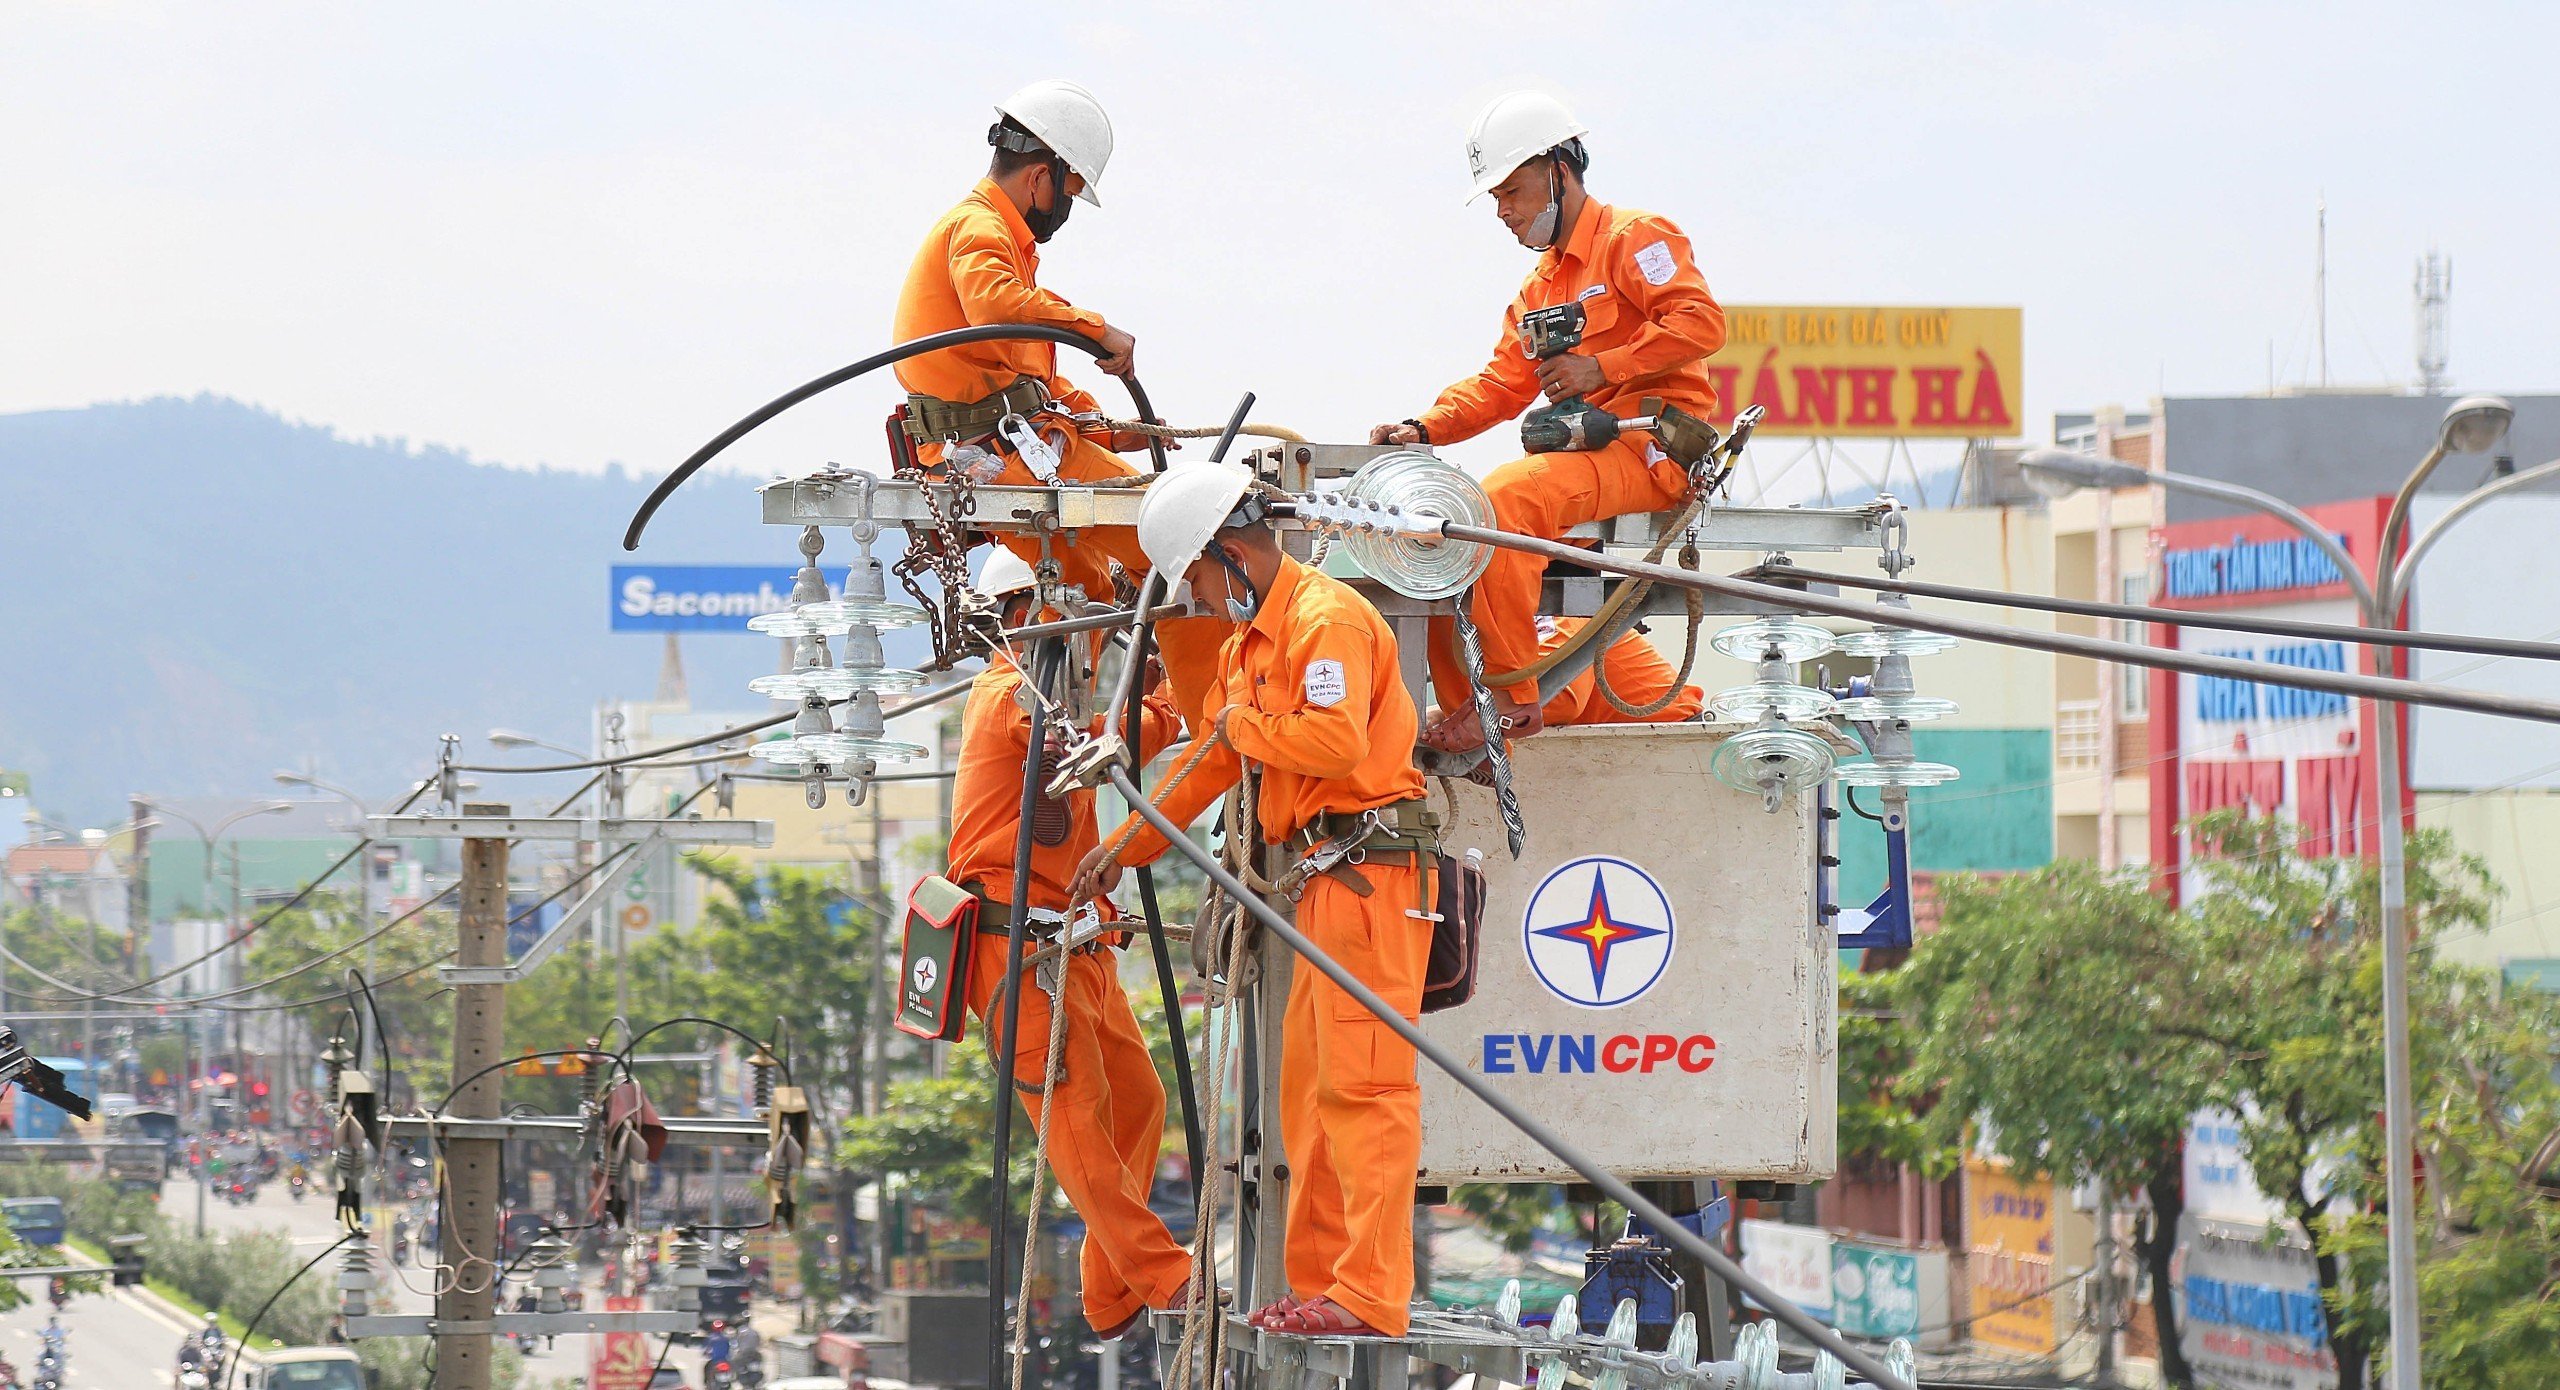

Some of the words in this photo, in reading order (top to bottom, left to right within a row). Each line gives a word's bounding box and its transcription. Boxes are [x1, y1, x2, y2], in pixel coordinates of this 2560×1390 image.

[1708, 346, 1897, 426] HÁNH
[1911, 348, 2012, 426] HÀ
[620, 576, 842, 617] Sacomb
[2165, 548, 2219, 598] TRUNG
[2258, 540, 2293, 590] NHA
